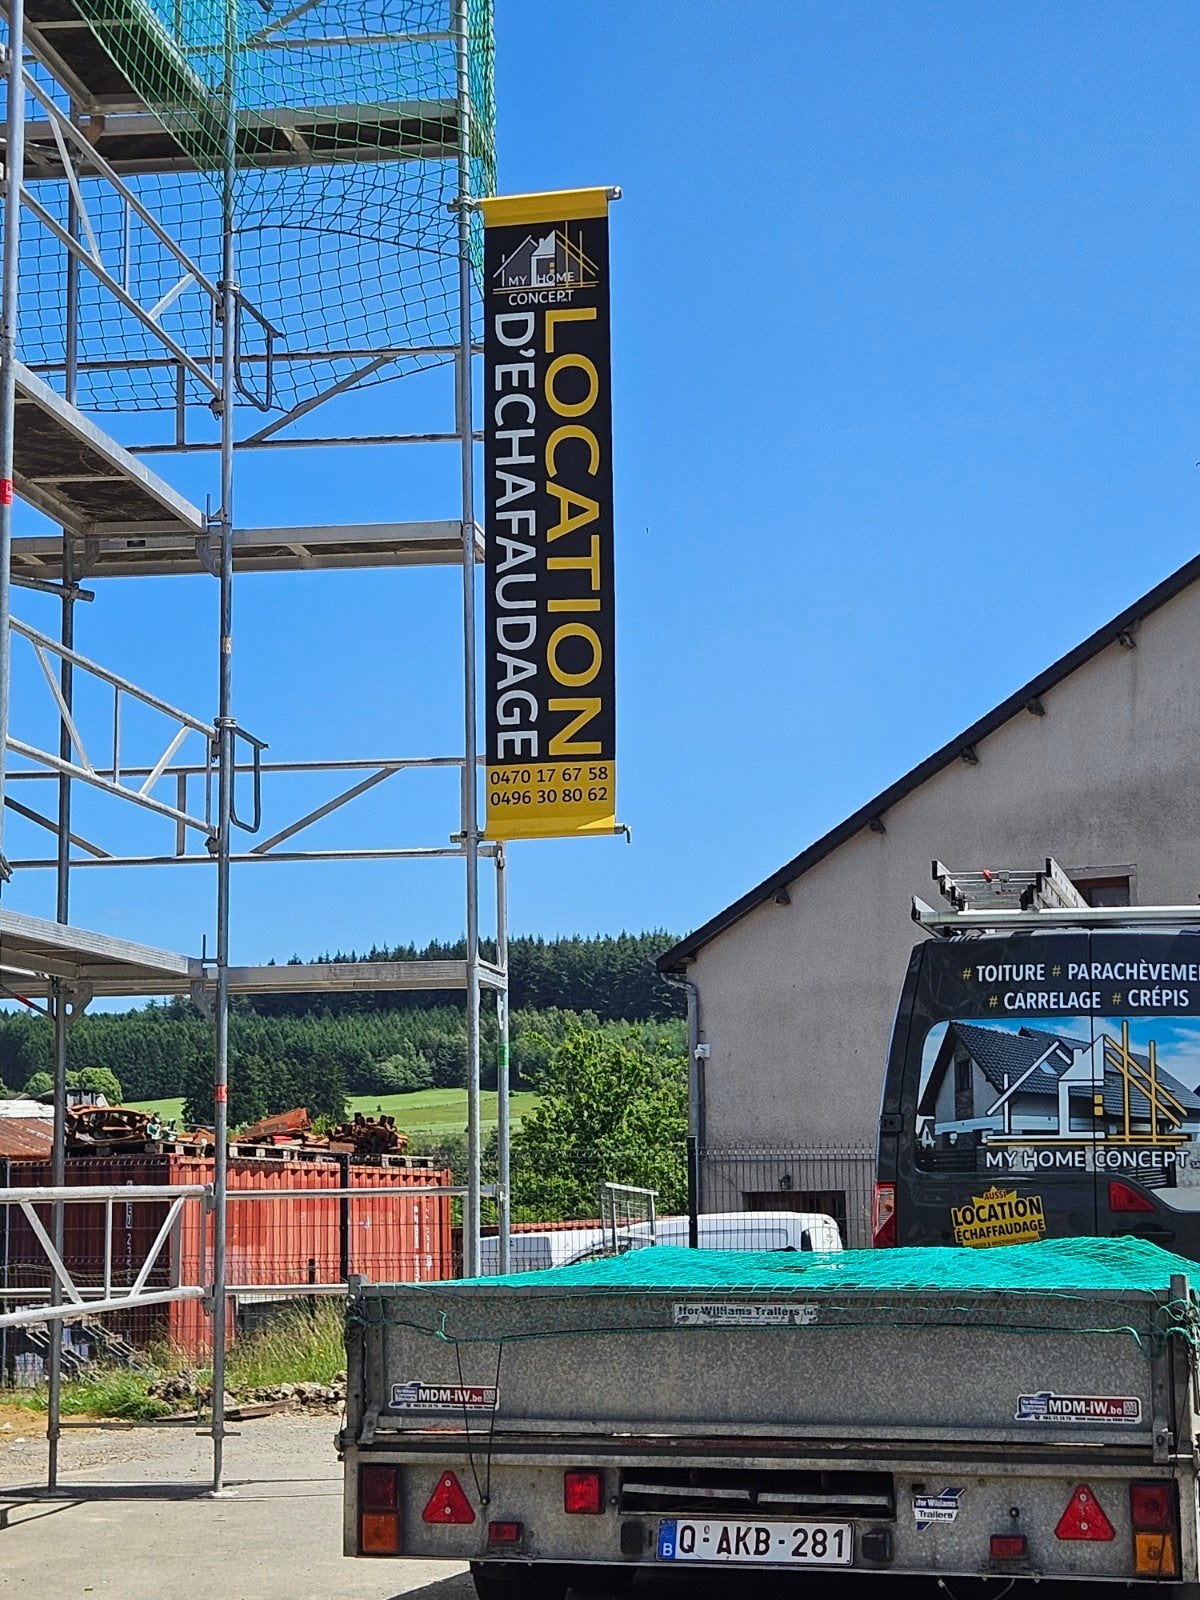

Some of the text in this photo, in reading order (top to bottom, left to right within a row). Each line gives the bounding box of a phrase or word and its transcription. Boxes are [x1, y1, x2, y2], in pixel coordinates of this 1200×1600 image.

[508, 271, 575, 286] MY HOME
[508, 289, 575, 306] CONCEPT
[494, 311, 539, 760] D'ECHAFAUDAGE
[545, 307, 602, 756] LOCATION
[490, 766, 608, 785] 0470 17 67 58
[490, 786, 608, 806] 0496 30 80 62
[976, 963, 1046, 982] TOITURE
[1068, 958, 1200, 982] PARACHÈVEME
[1003, 991, 1101, 1010] CARRELAGE
[1128, 985, 1190, 1007] CRÉPIS
[986, 1151, 1017, 1168] MY
[1023, 1150, 1086, 1168] HOME
[1095, 1150, 1190, 1168] CONCEPT
[984, 1190, 1007, 1201] AUSSI
[952, 1197, 1042, 1227] LOCATION
[954, 1218, 1045, 1242] ÉCHAFFAUDAGE
[701, 1305, 752, 1316] Williams
[754, 1306, 800, 1316] Trailers
[918, 1510, 953, 1519] Trailers
[662, 1542, 673, 1557] B
